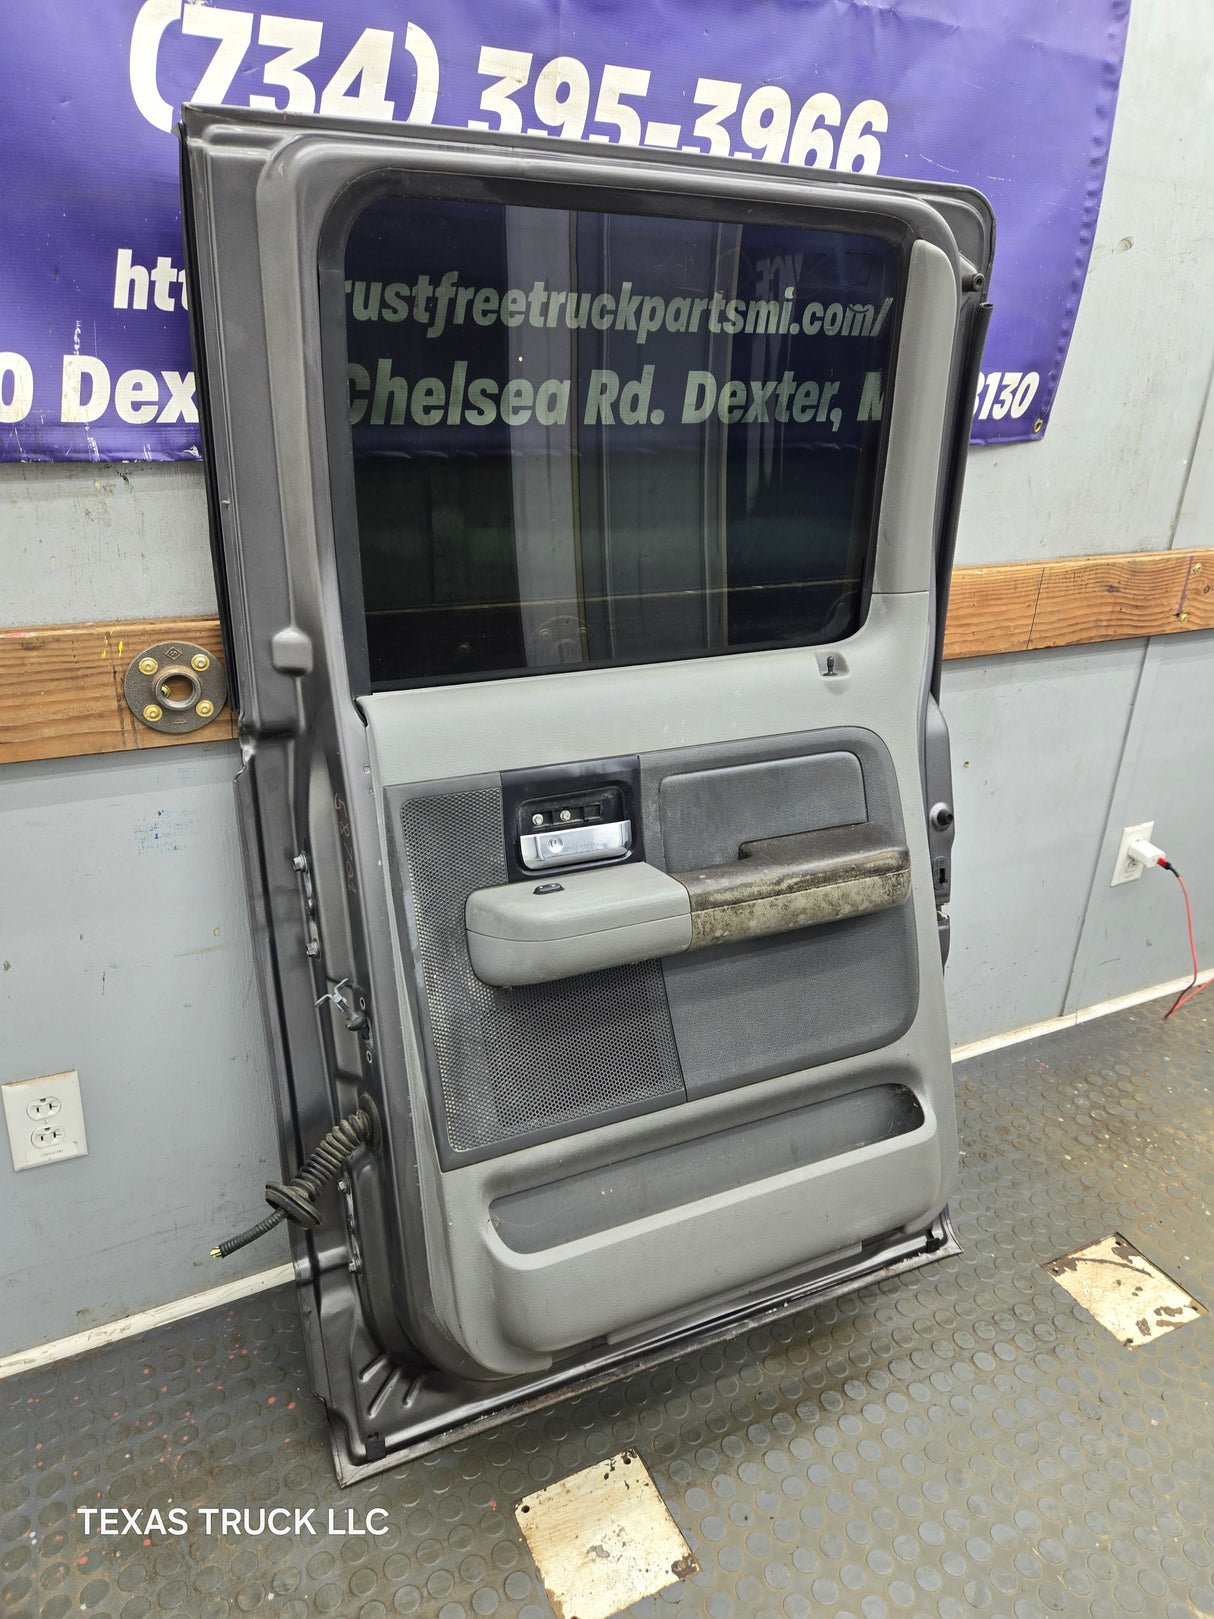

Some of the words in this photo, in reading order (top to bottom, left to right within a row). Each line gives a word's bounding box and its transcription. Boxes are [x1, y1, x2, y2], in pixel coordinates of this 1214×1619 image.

[129, 0, 440, 133] (734)
[467, 45, 890, 175] 395-3966
[583, 364, 665, 426] Rd.
[681, 370, 843, 432] Dexter,
[973, 371, 1040, 420] 130
